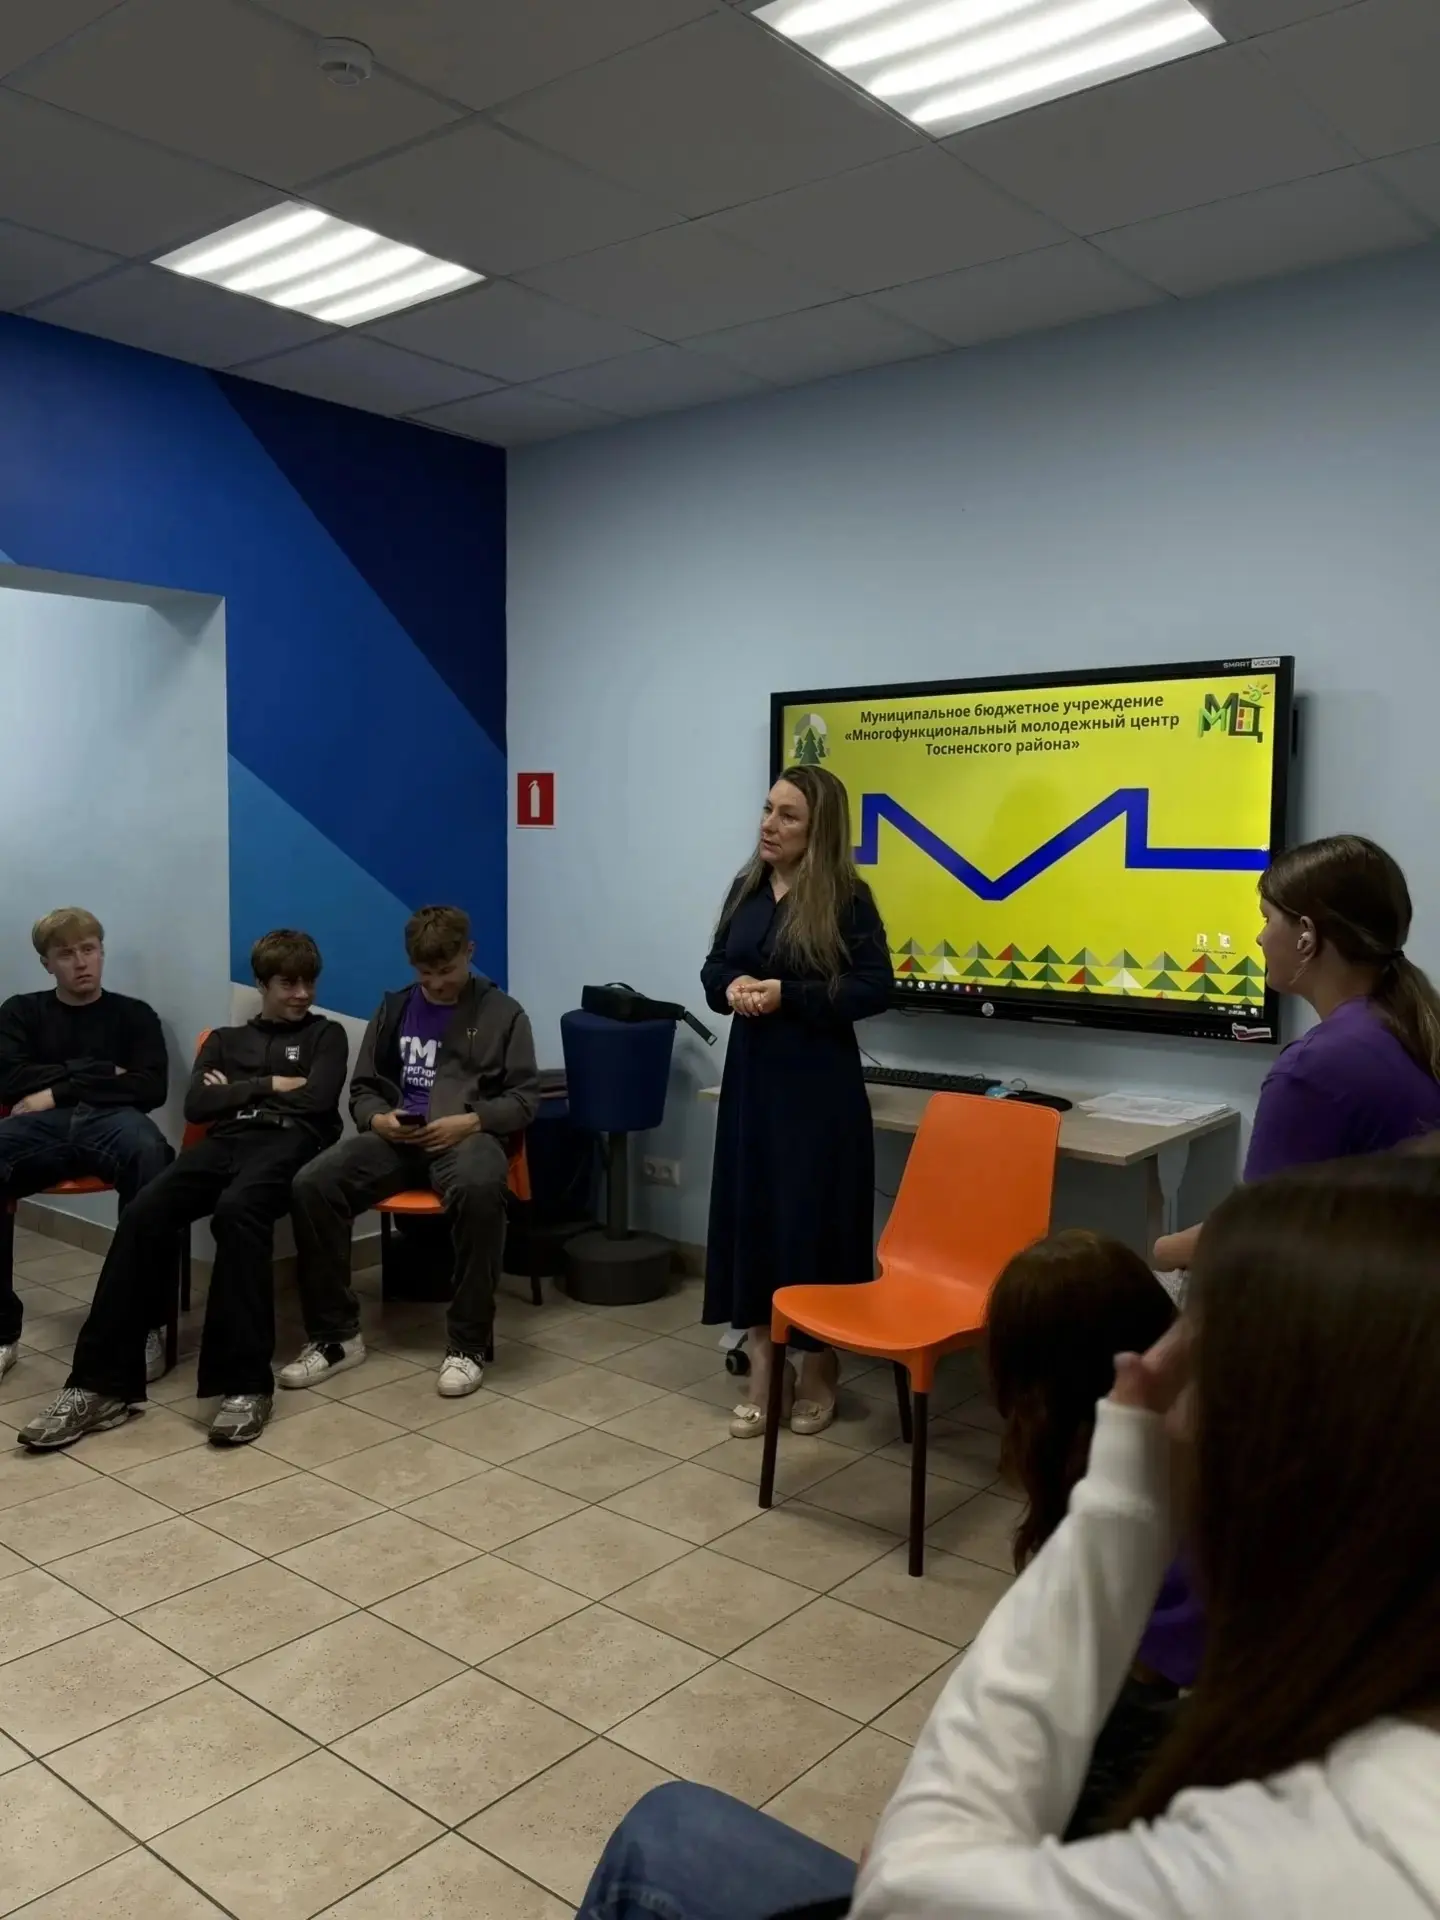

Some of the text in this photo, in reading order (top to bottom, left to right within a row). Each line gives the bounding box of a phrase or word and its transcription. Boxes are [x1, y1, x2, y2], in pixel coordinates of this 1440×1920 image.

[1223, 661, 1251, 669] SMART
[860, 695, 1164, 724] Муниципальное бюджетное учреждение
[845, 714, 1180, 742] «Многофункциональный молодежный центр
[925, 737, 1081, 756] Тосненского района»
